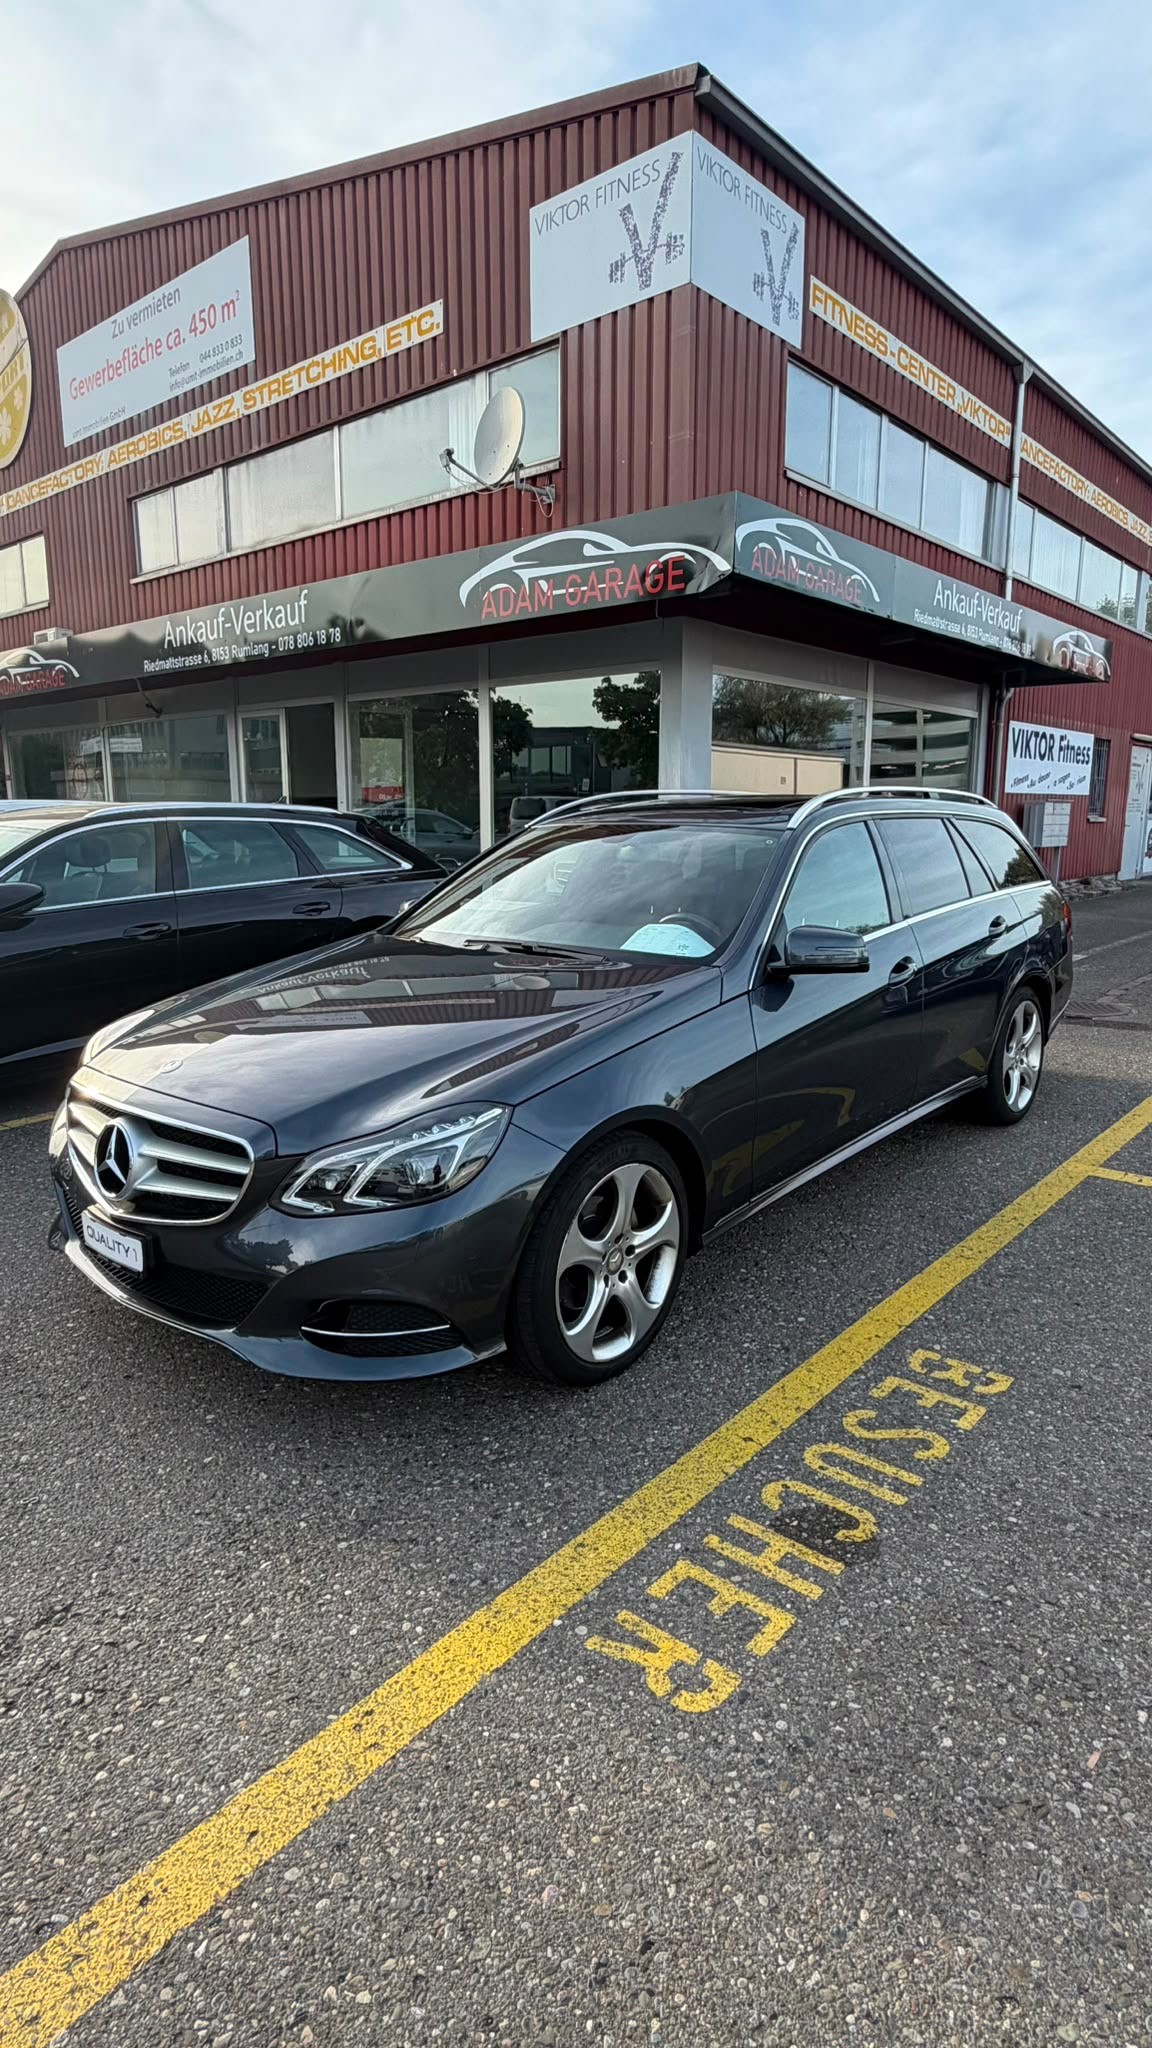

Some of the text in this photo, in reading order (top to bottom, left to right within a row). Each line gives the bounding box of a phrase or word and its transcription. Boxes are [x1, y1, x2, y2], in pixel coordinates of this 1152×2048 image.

[534, 159, 661, 236] VIKTOR FITNESS
[697, 146, 788, 234] VIKTOR FITNESS
[111, 287, 181, 339] Zu vermieten
[69, 336, 163, 401] Gewerbefläche
[166, 327, 186, 351] ca.
[189, 303, 217, 338] 450
[168, 362, 191, 378] Telefon
[199, 349, 211, 363] 044
[212, 343, 224, 357] 833
[230, 333, 243, 349] 833
[190, 397, 241, 433] JAZZ,
[243, 336, 382, 412] STRETCHING,
[386, 309, 441, 350] ETC.
[109, 405, 126, 421] GmbH
[481, 555, 685, 620] ADAM GARAGE
[751, 548, 862, 602] ADAM GARAGE
[164, 589, 309, 649] Ankauf-Verkauf
[933, 579, 1023, 633] Ankauf-Verkauf
[143, 654, 203, 673] Riedmattstrasse
[212, 646, 230, 661] 8153
[231, 642, 269, 658] Rumlang
[278, 634, 295, 651] 078
[296, 632, 314, 648] 806
[317, 630, 326, 645] 18
[329, 627, 341, 643] 78
[1012, 727, 1091, 765] VIKTOR Fitness
[86, 1225, 131, 1258] QUALITY
